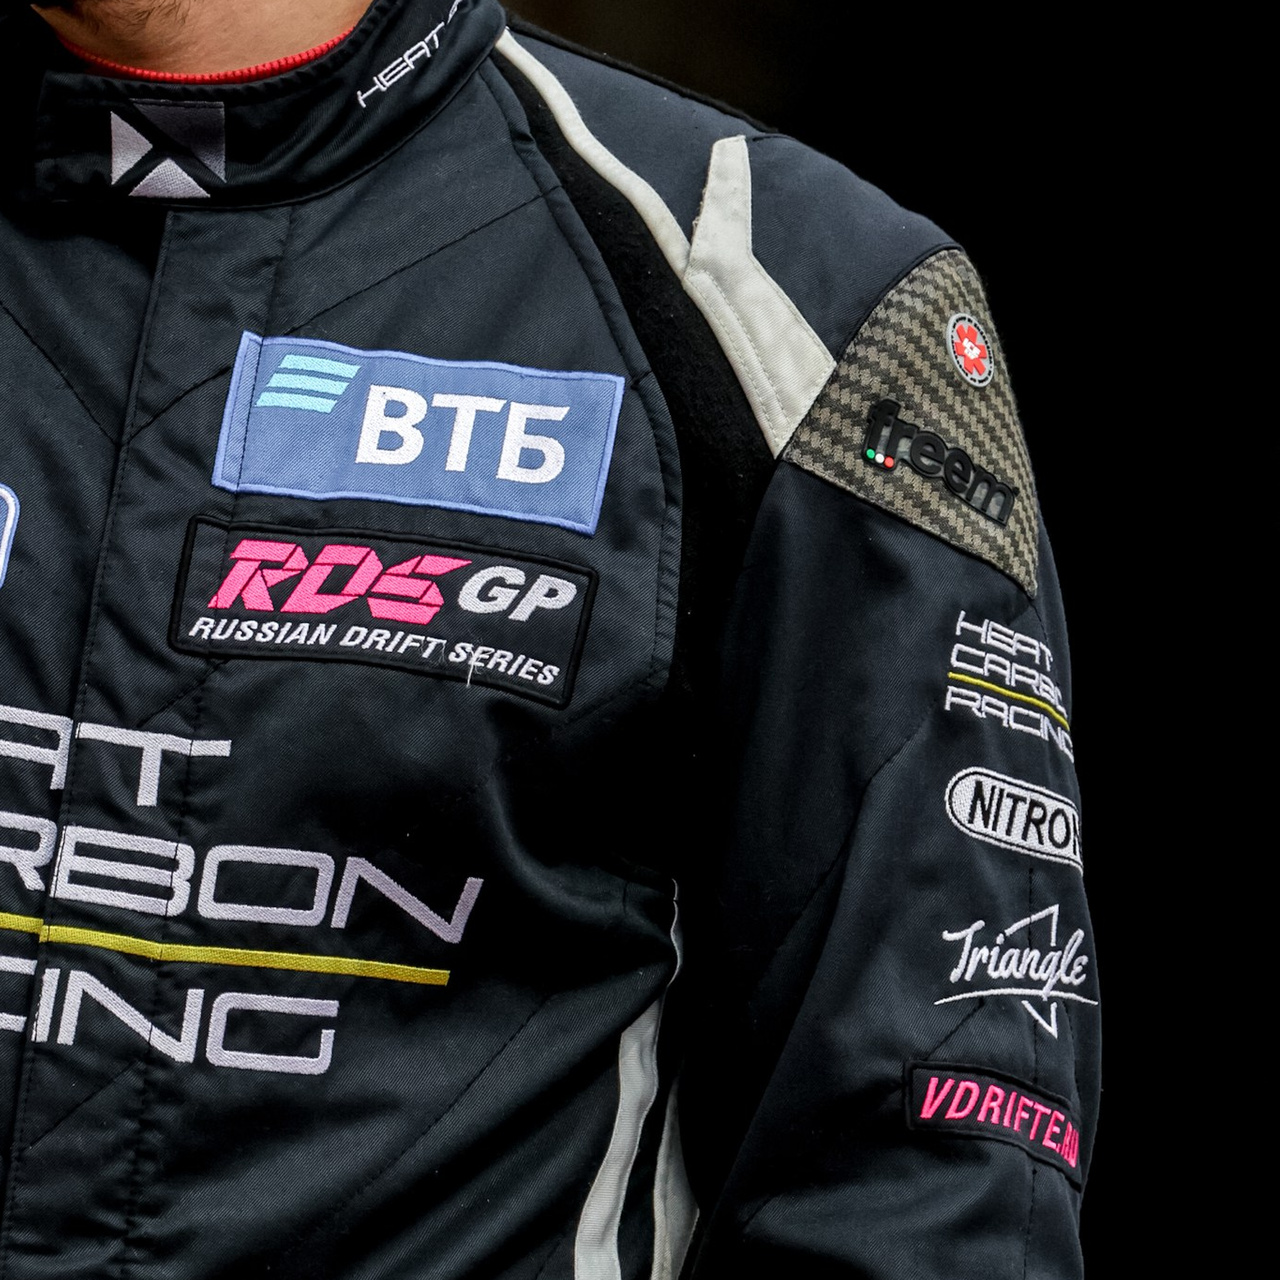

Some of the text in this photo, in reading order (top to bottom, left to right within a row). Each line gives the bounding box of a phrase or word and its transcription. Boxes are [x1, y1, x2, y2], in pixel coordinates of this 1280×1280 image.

[356, 21, 445, 108] HEAT
[354, 383, 571, 486] ВТБ
[863, 399, 1017, 526] freem
[207, 538, 578, 626] RDS GP
[188, 616, 561, 686] RUSSIAN DRIFT SERIES
[955, 610, 1054, 672] HEAT
[942, 919, 1089, 1001] Triangle
